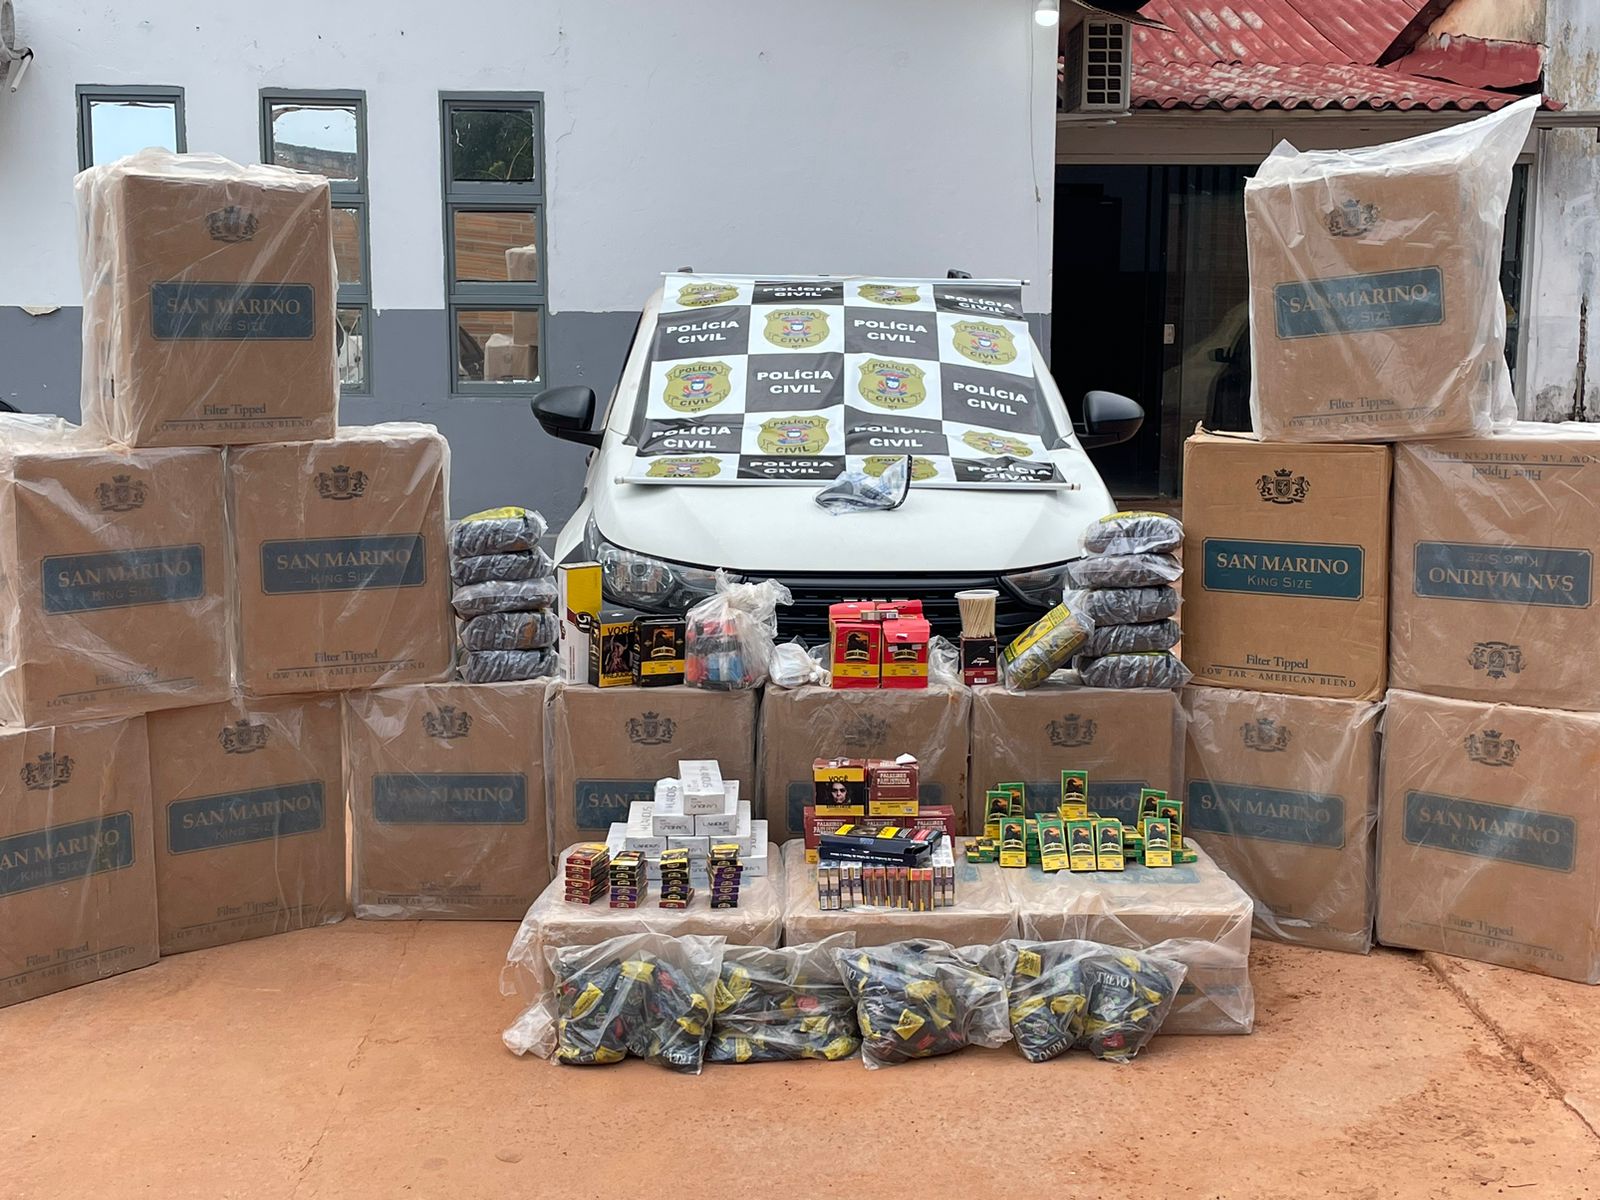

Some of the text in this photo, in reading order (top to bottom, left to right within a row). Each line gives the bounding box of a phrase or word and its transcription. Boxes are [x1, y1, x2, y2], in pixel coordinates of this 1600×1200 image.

[944, 294, 1014, 310] POLÍCIA
[1290, 284, 1428, 313] SAN MARINO
[167, 298, 301, 315] SAN MARINO
[778, 309, 816, 317] POLÍCIA
[958, 302, 1005, 314] CIVIL
[666, 320, 740, 334] POLÍCIA
[854, 319, 928, 333] POLÍCIA
[964, 325, 1002, 334] POLÍCIA
[678, 334, 726, 344] CIVIL
[867, 332, 916, 344] CIVIL
[970, 350, 1000, 360] CIVIL
[678, 364, 719, 374] POLÍCIA
[872, 363, 912, 372] POLÍCIA
[757, 370, 834, 380] POLÍCIA
[770, 385, 821, 394] CIVIL
[953, 382, 1029, 404] POLÍCIA
[680, 398, 713, 406] CIVIL
[876, 395, 908, 404] CIVIL
[1329, 399, 1354, 410] Filter
[204, 403, 266, 416] Filter Tipped
[968, 399, 1017, 415] CIVIL
[652, 426, 731, 438] POLÍCIA
[664, 439, 716, 448] CIVIL
[869, 438, 923, 448] CIVIL
[277, 548, 412, 570] SAN MARINO
[1216, 552, 1349, 575] SAN MARINO
[58, 561, 192, 588] SAN MARINO
[1248, 574, 1312, 589] KING SIZE
[1429, 567, 1574, 592] SAN MARINO
[314, 649, 378, 663] Filter Tipped
[1246, 654, 1309, 670] Filter Tipped
[266, 672, 290, 680] LOW
[328, 666, 386, 677] AMERICAN
[1201, 666, 1222, 676] LOW
[1228, 670, 1247, 678] TAR
[1258, 672, 1315, 684] AMERICAN
[1320, 678, 1356, 688] BLEND
[431, 787, 514, 803] MARINO
[588, 793, 628, 808] SAN
[183, 795, 311, 829] SAN MARINO
[1201, 795, 1331, 824] SAN MARINO
[1420, 807, 1560, 846] SAN MARINO
[0, 829, 120, 870] AN MARINO
[1478, 920, 1514, 936] Tipped
[1097, 971, 1130, 989] TREVO
